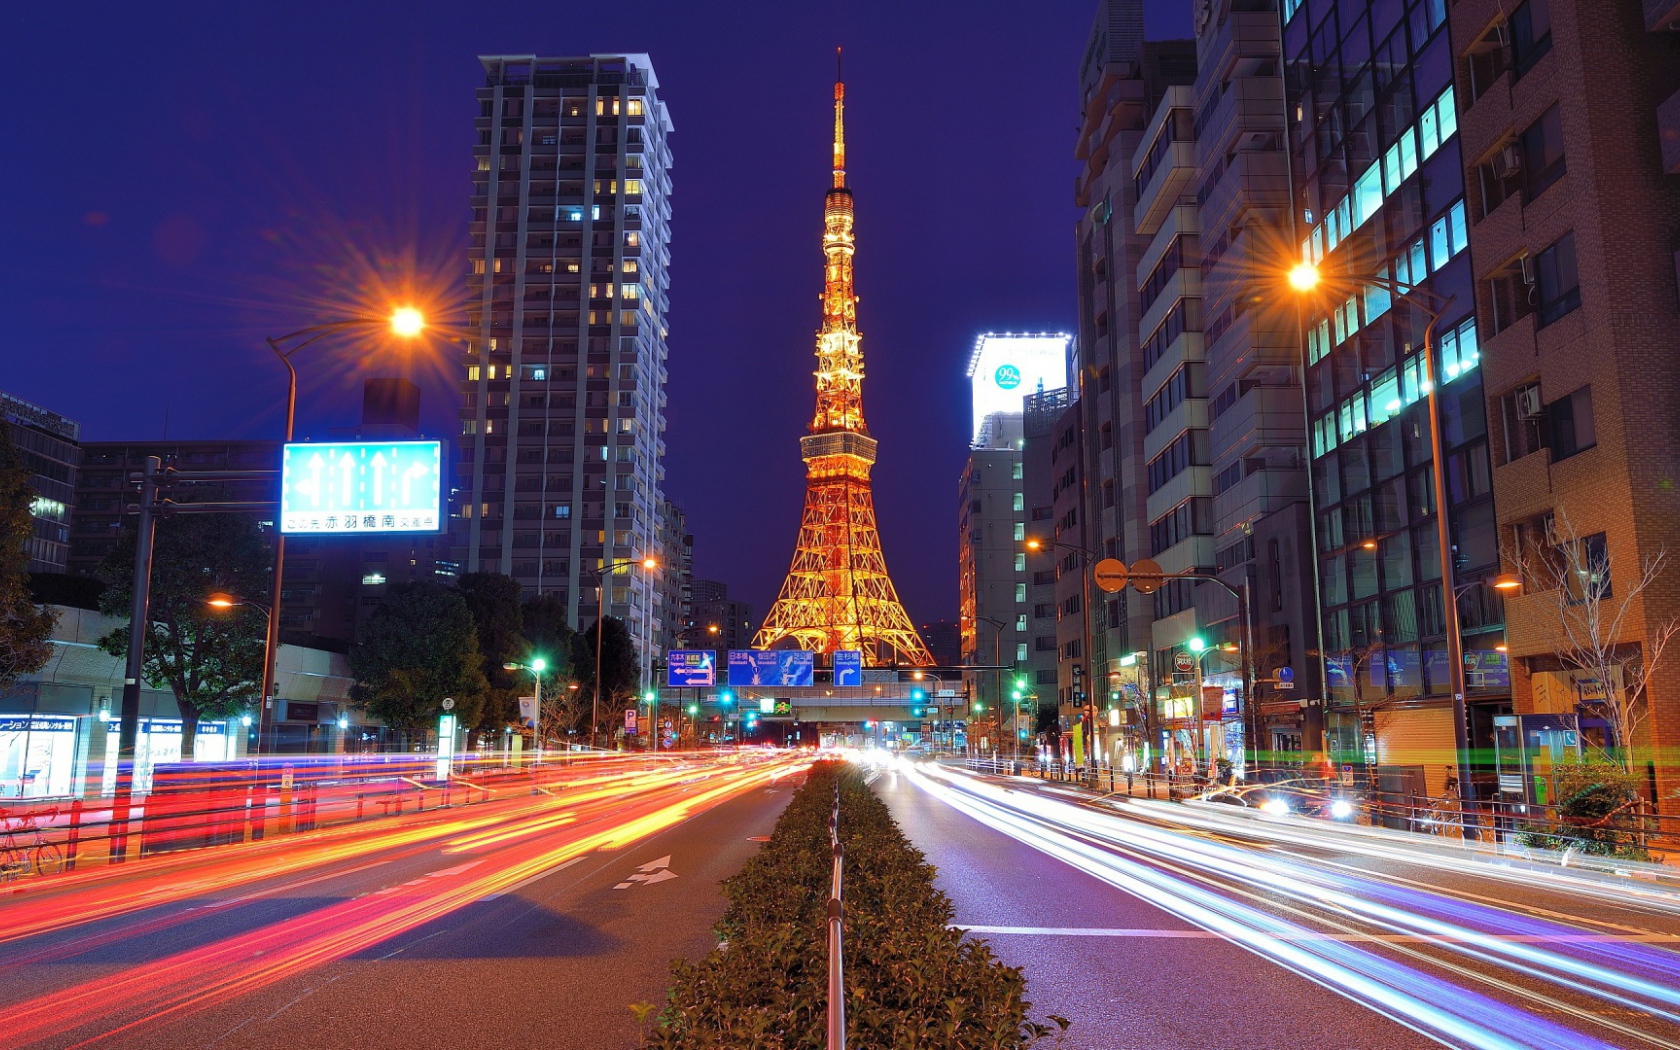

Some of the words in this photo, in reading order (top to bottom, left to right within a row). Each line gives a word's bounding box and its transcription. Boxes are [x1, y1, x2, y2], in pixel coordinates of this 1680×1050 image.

[325, 515, 395, 529] 赤羽橋南
[670, 653, 685, 662] 六本木
[729, 652, 748, 660] 日本橋
[793, 652, 812, 660] 芝公園
[836, 652, 859, 661] 金杉橋
[627, 711, 634, 720] P
